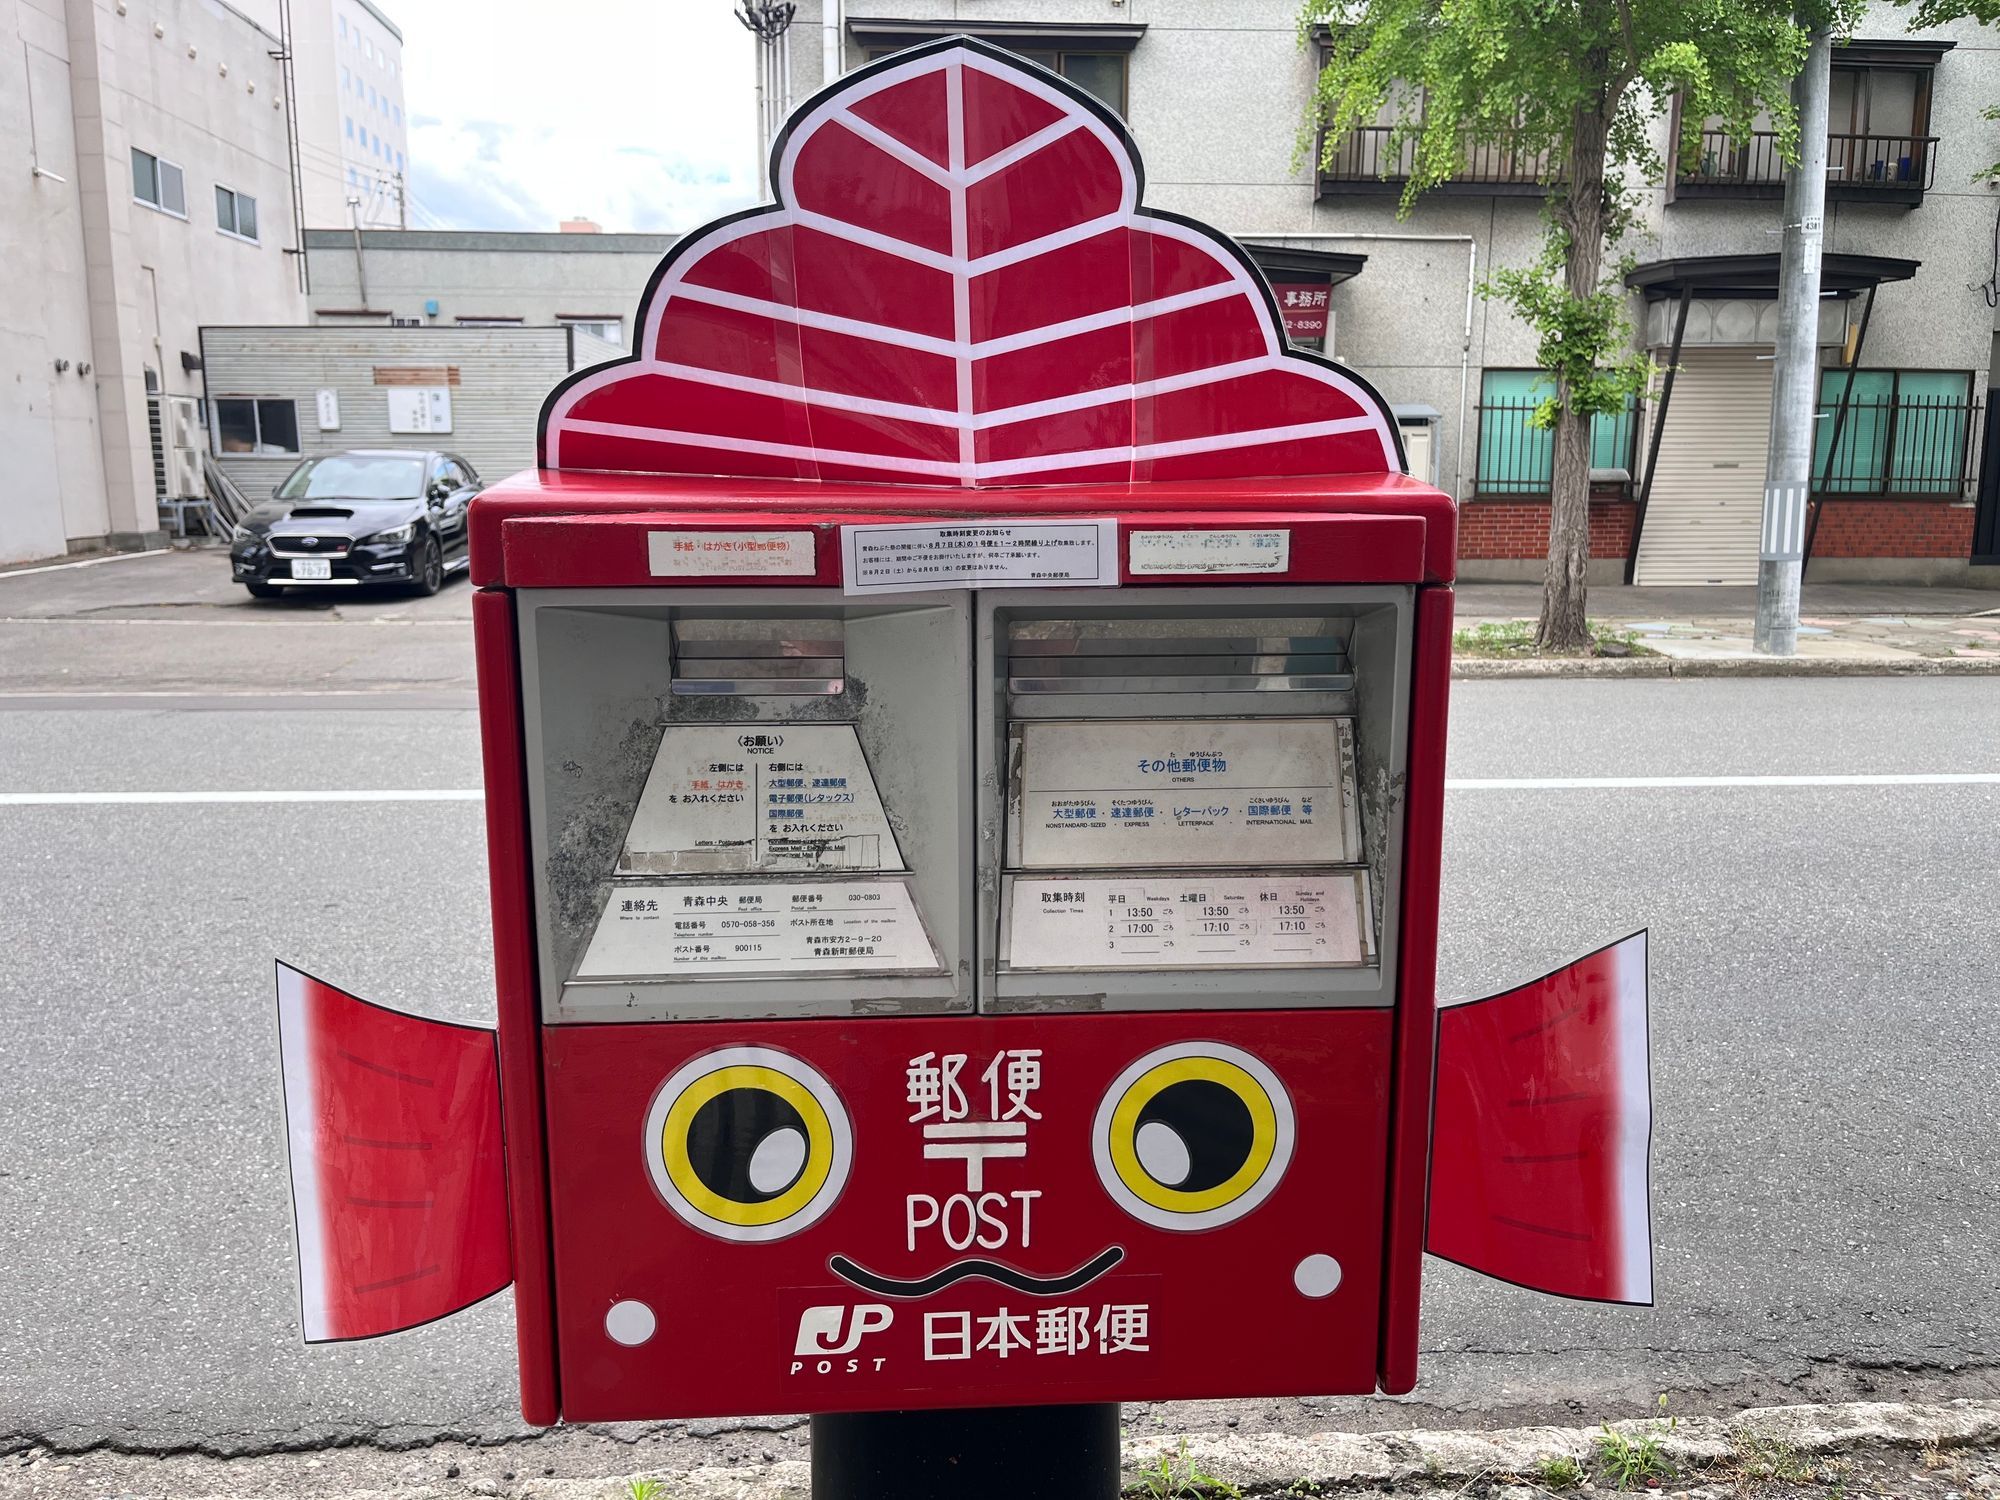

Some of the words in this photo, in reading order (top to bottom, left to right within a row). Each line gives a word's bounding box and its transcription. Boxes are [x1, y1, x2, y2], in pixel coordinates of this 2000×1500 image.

[1284, 291, 1327, 307] 事務所
[940, 529, 1011, 538] 取集時刻変更のお知らせ
[709, 763, 744, 772] 左側には
[769, 763, 804, 772] 右側には
[1138, 758, 1226, 773] その他郵便物
[682, 794, 744, 803] お入れください
[769, 809, 804, 818] 国際郵便
[1053, 808, 1096, 819] 大型郵便
[1110, 807, 1154, 818] 速達郵便
[1248, 805, 1291, 816] 国際郵便
[783, 823, 844, 832] お入れください
[683, 896, 728, 907] 青森中央
[739, 896, 762, 904] 郵便局
[792, 894, 823, 903] 郵便番号
[1041, 892, 1085, 903] 取集時刻
[1108, 895, 1126, 903] 平日
[1180, 893, 1206, 903] 土曜日
[1260, 893, 1278, 901] 休日
[621, 900, 658, 912] 連絡先
[1203, 906, 1229, 916] 13:50
[1279, 905, 1305, 915] 13:50
[1127, 908, 1153, 917] 13:50
[674, 921, 706, 929] 電話番号
[721, 919, 775, 929] 0570-058-356
[790, 918, 834, 927] ポスト所在地
[1203, 922, 1229, 932] 17:10
[1279, 921, 1305, 931] 17:10
[1127, 924, 1153, 933] 17:00
[674, 945, 710, 953] ポスト番号
[735, 944, 762, 952] 900115
[814, 946, 874, 957] 青森新町郵便局
[906, 1049, 1043, 1123] 郵便
[906, 1190, 1043, 1252] POST
[923, 1304, 1150, 1361] 日本郵便
[790, 1358, 886, 1375] POST
